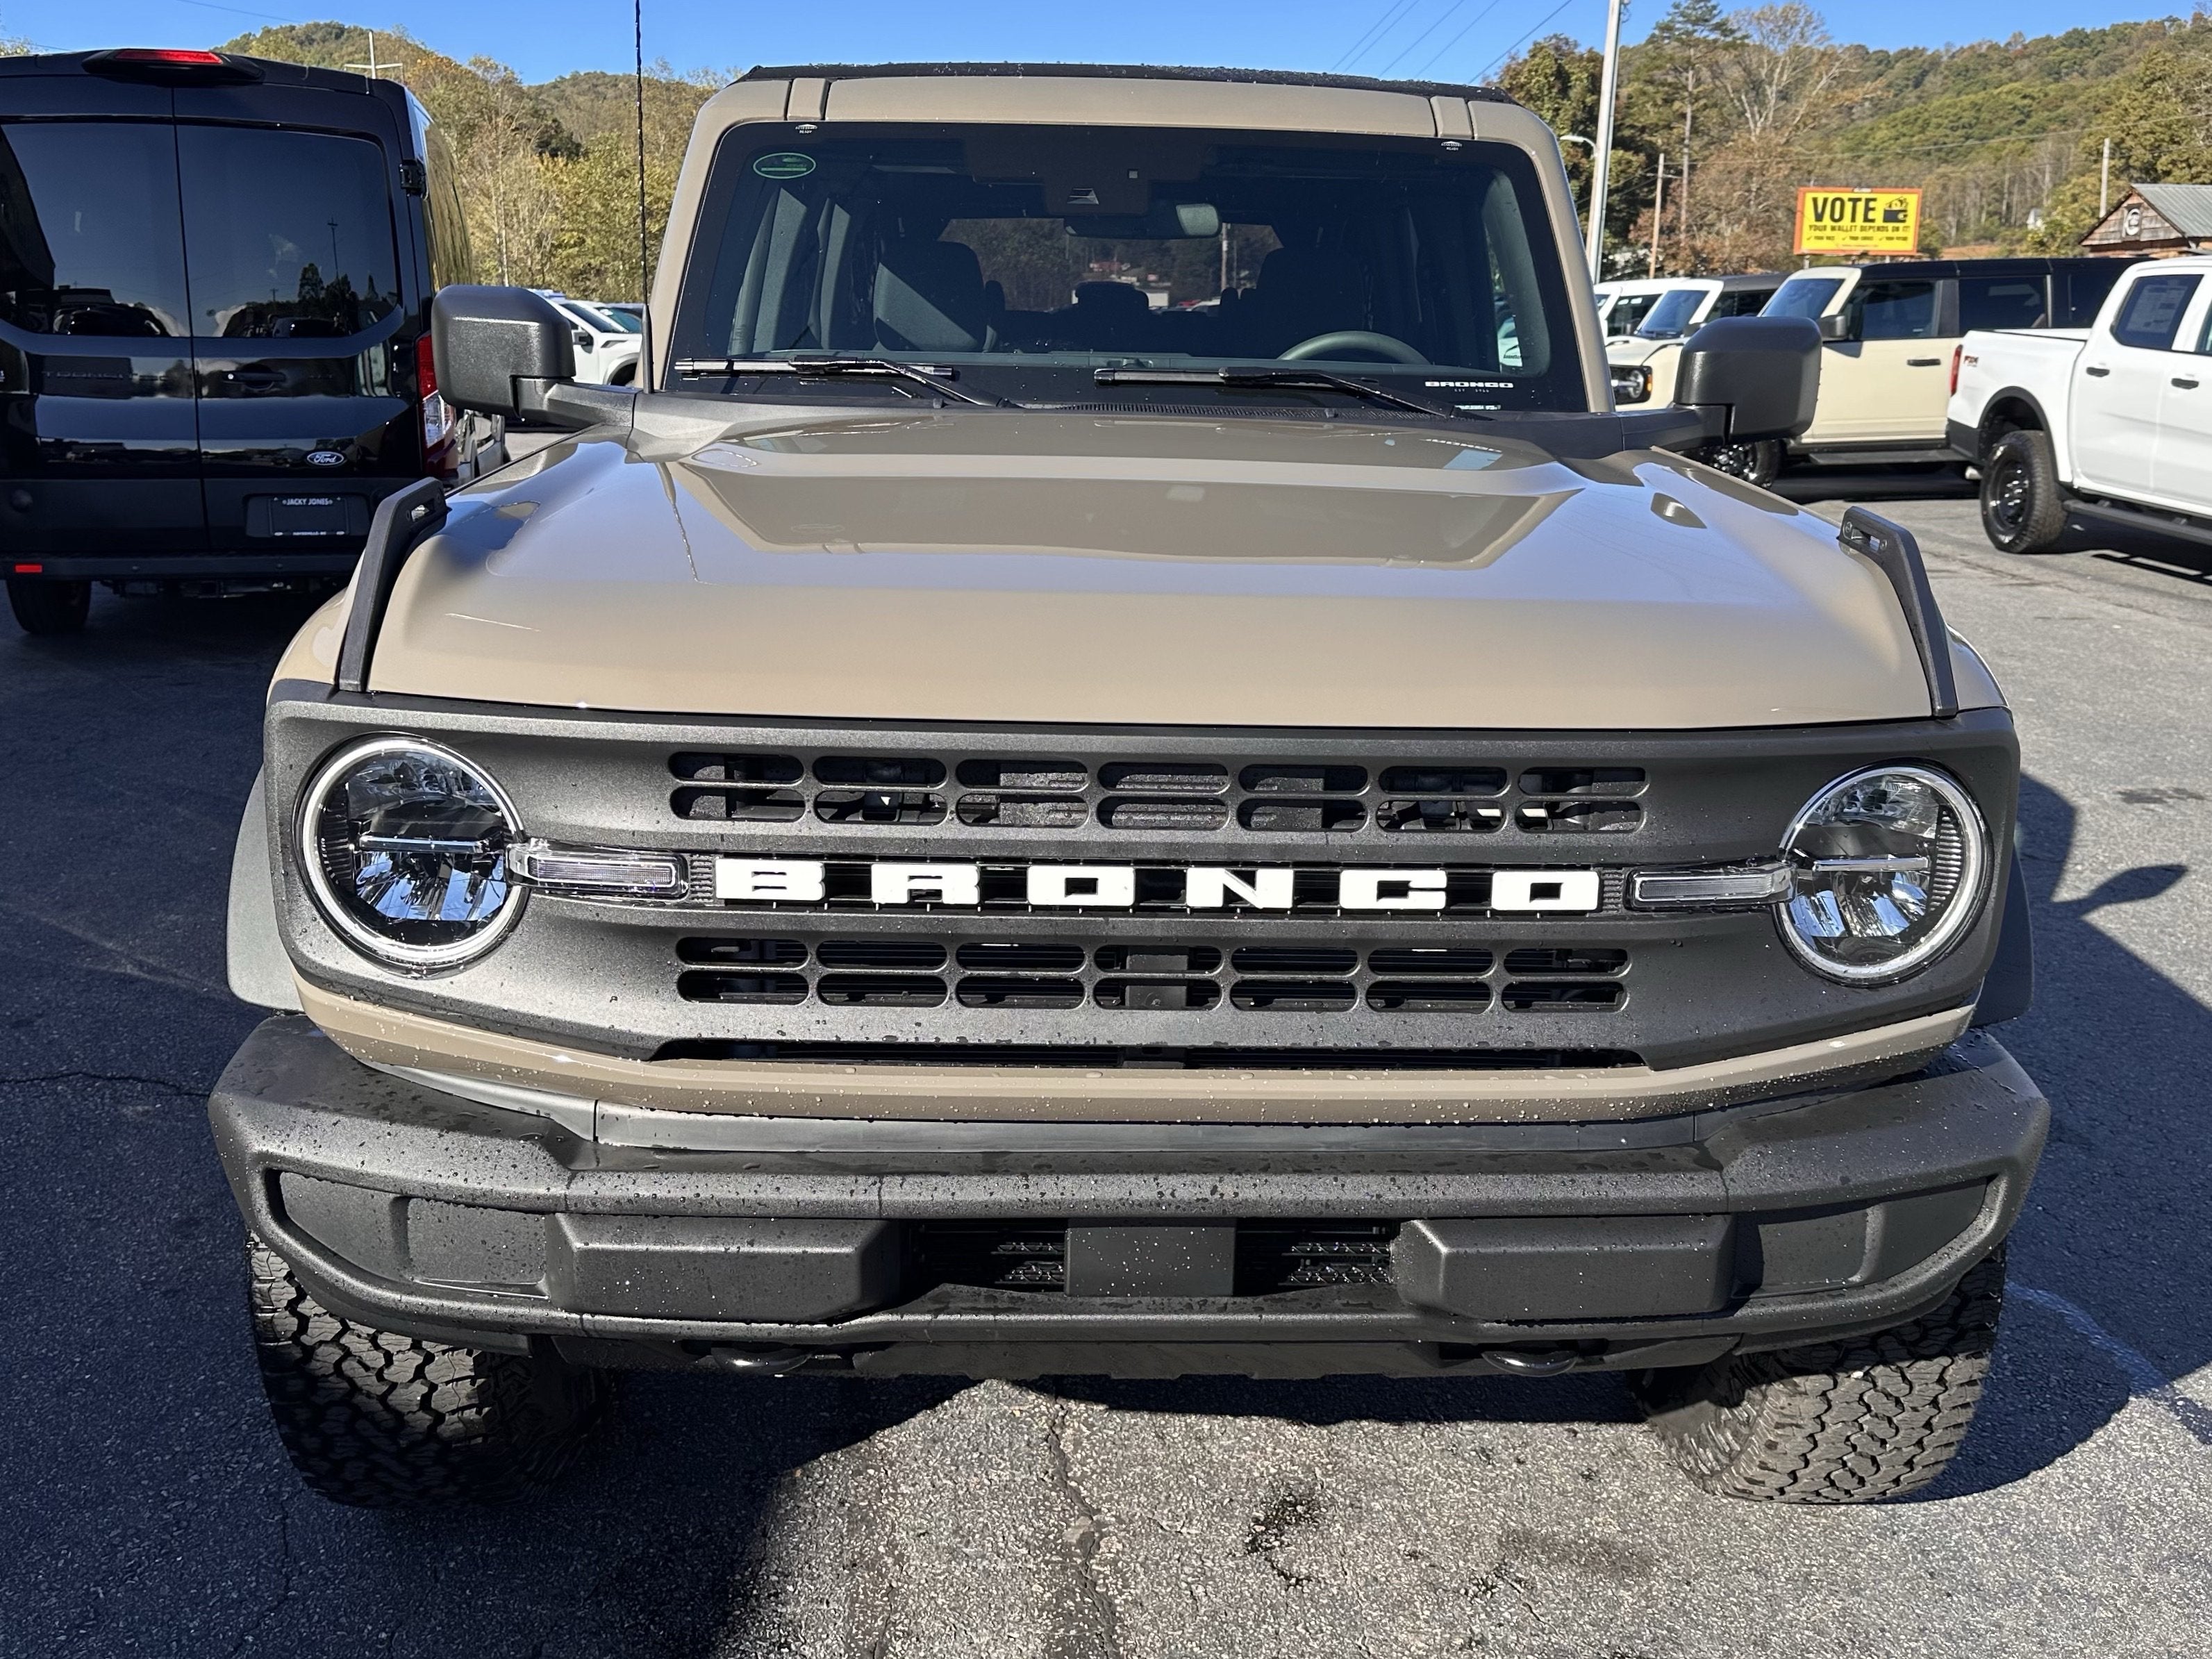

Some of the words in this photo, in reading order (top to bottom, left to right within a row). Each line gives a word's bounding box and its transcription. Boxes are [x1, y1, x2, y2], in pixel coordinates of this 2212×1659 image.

[1811, 197, 1878, 223] VOTE
[313, 453, 336, 463] Ford
[715, 858, 1599, 911] BRONCO
